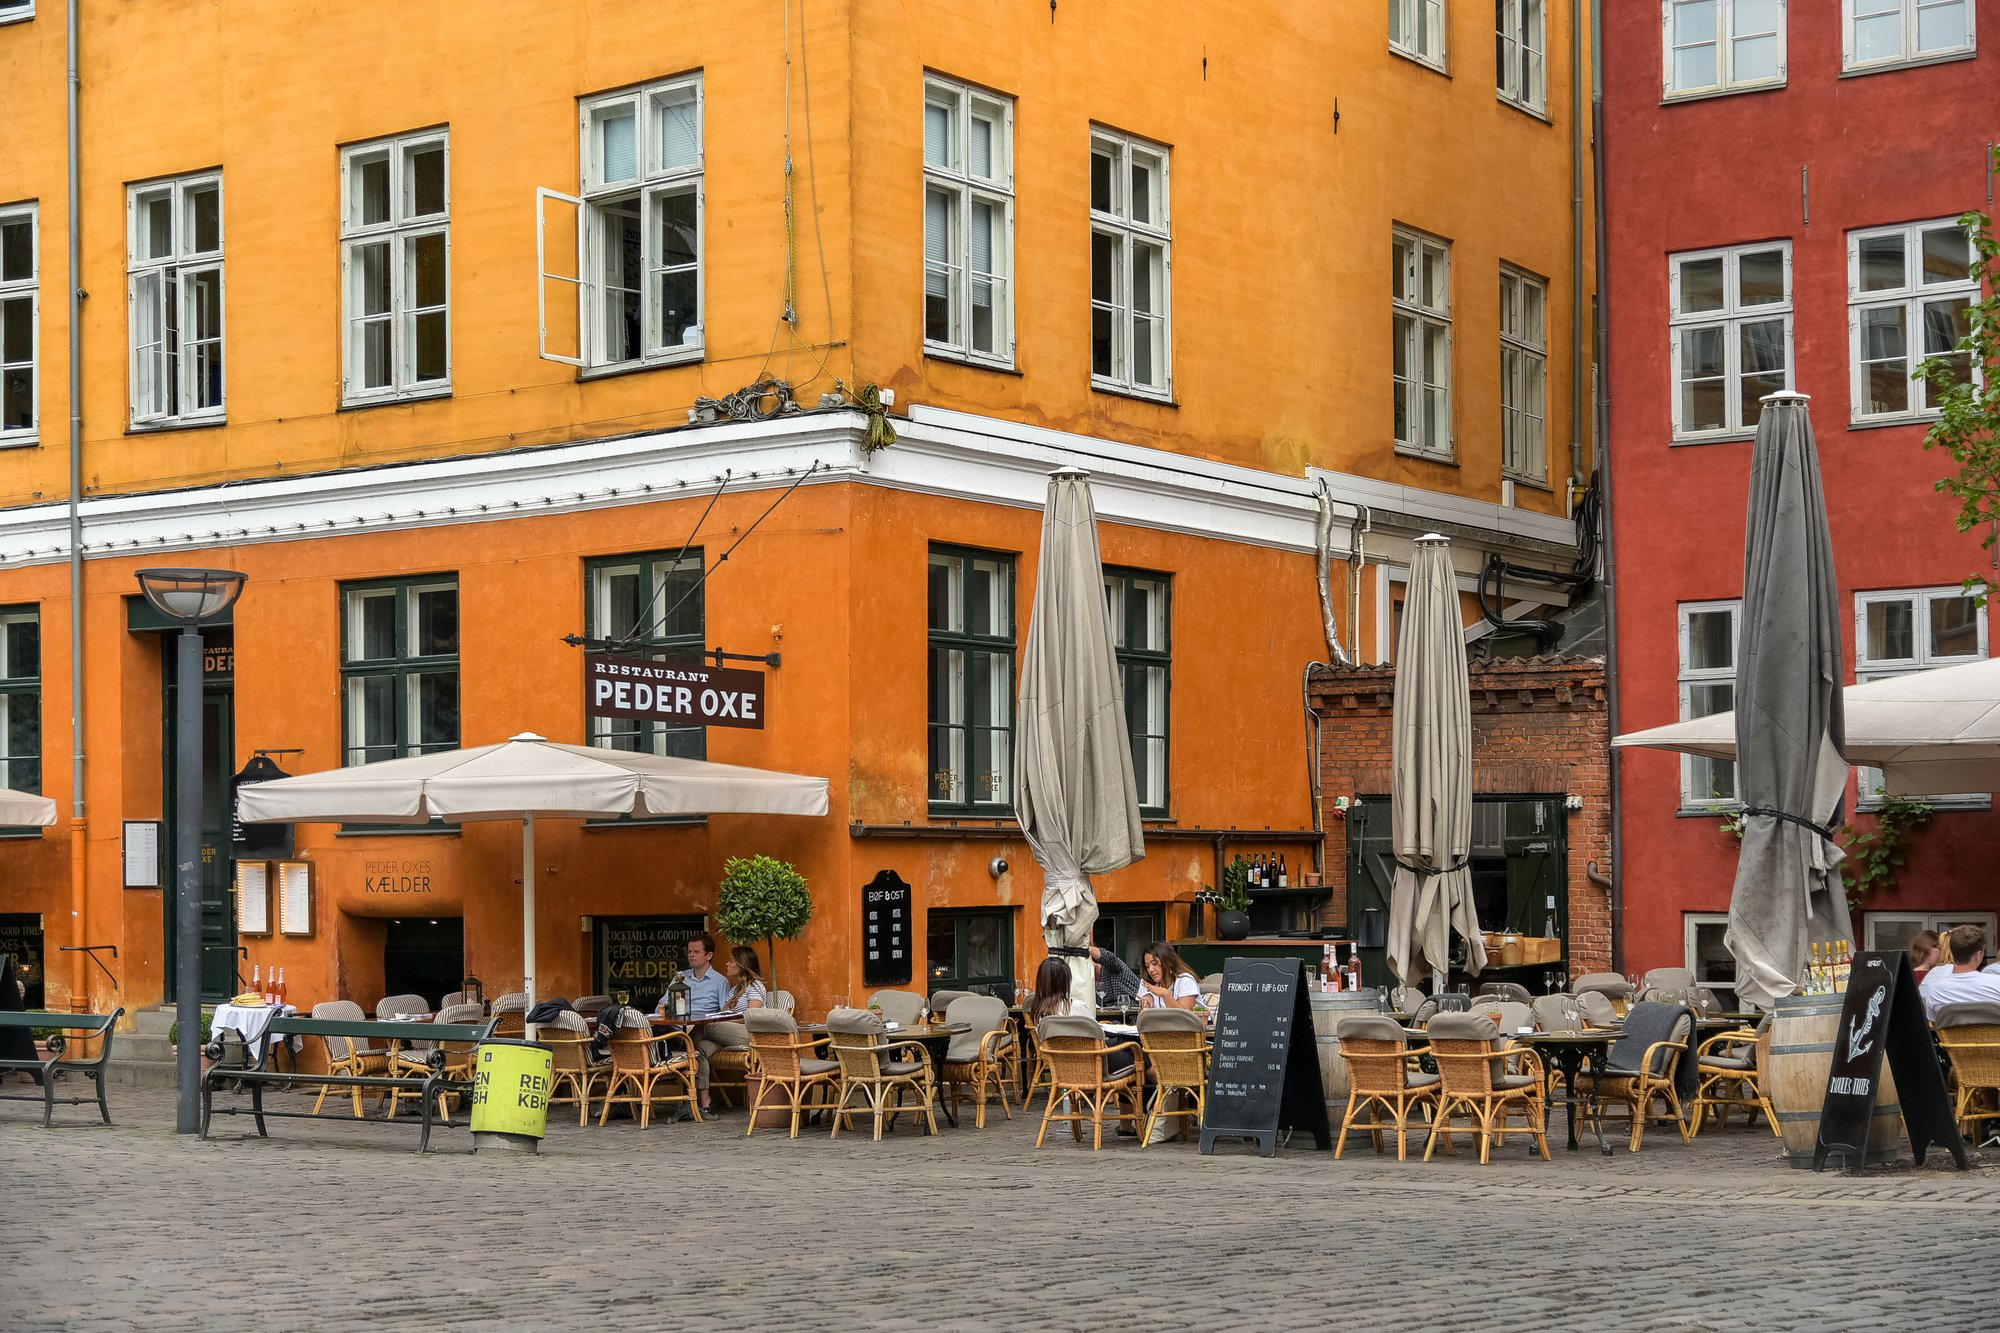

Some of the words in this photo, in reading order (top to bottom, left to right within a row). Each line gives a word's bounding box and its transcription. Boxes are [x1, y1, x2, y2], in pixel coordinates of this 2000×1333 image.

[595, 663, 709, 683] RESTAURANT
[595, 679, 692, 714] PEDER
[700, 689, 757, 719] OXE
[365, 861, 398, 873] PEDER
[402, 860, 431, 873] OXES
[365, 876, 431, 892] KÆLDER
[1, 927, 20, 936] GOOD
[657, 930, 678, 940] GOOD
[646, 946, 679, 959] OXES
[608, 961, 678, 978] KÆLDER
[1227, 983, 1253, 991] FROKOST
[520, 1074, 549, 1093] REN
[517, 1093, 547, 1112] KBH
